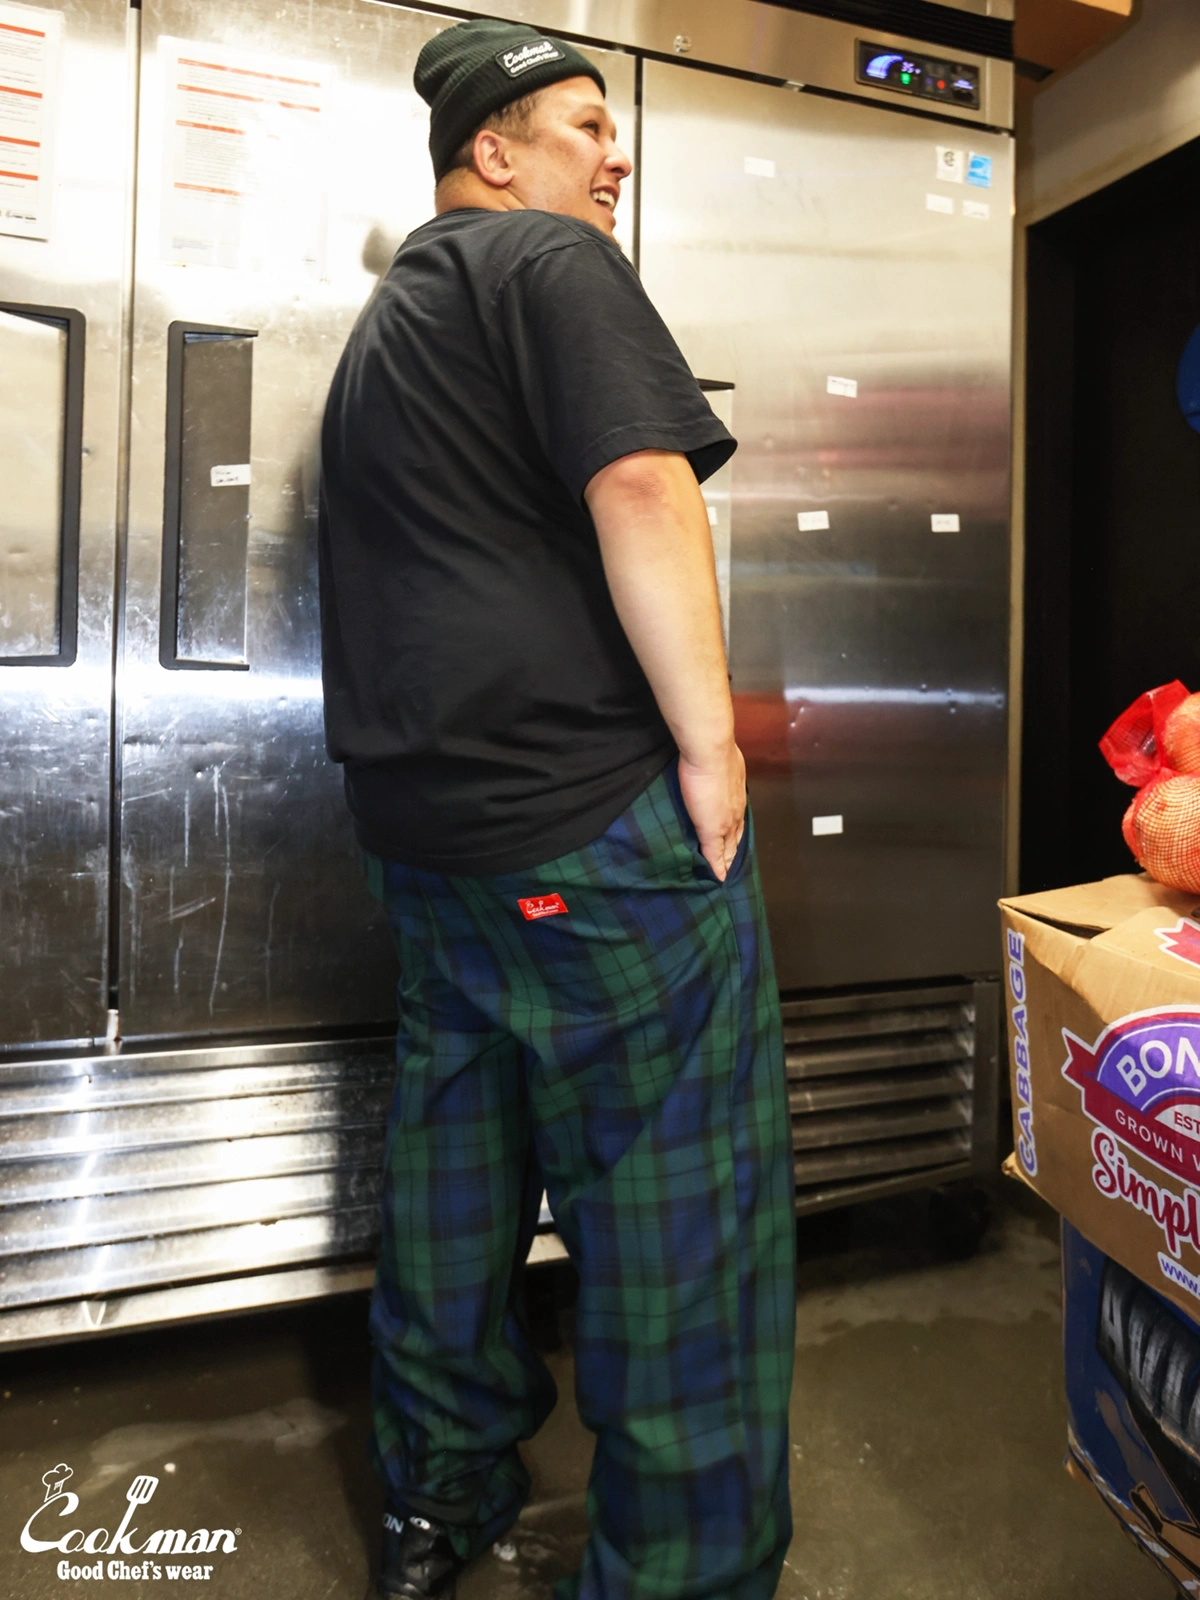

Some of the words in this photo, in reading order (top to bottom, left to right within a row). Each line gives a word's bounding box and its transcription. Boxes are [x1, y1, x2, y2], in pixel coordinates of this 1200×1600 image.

[503, 41, 554, 68] Cookman
[1008, 931, 1036, 1175] CABBAGE
[1115, 1109, 1183, 1164] GROWN
